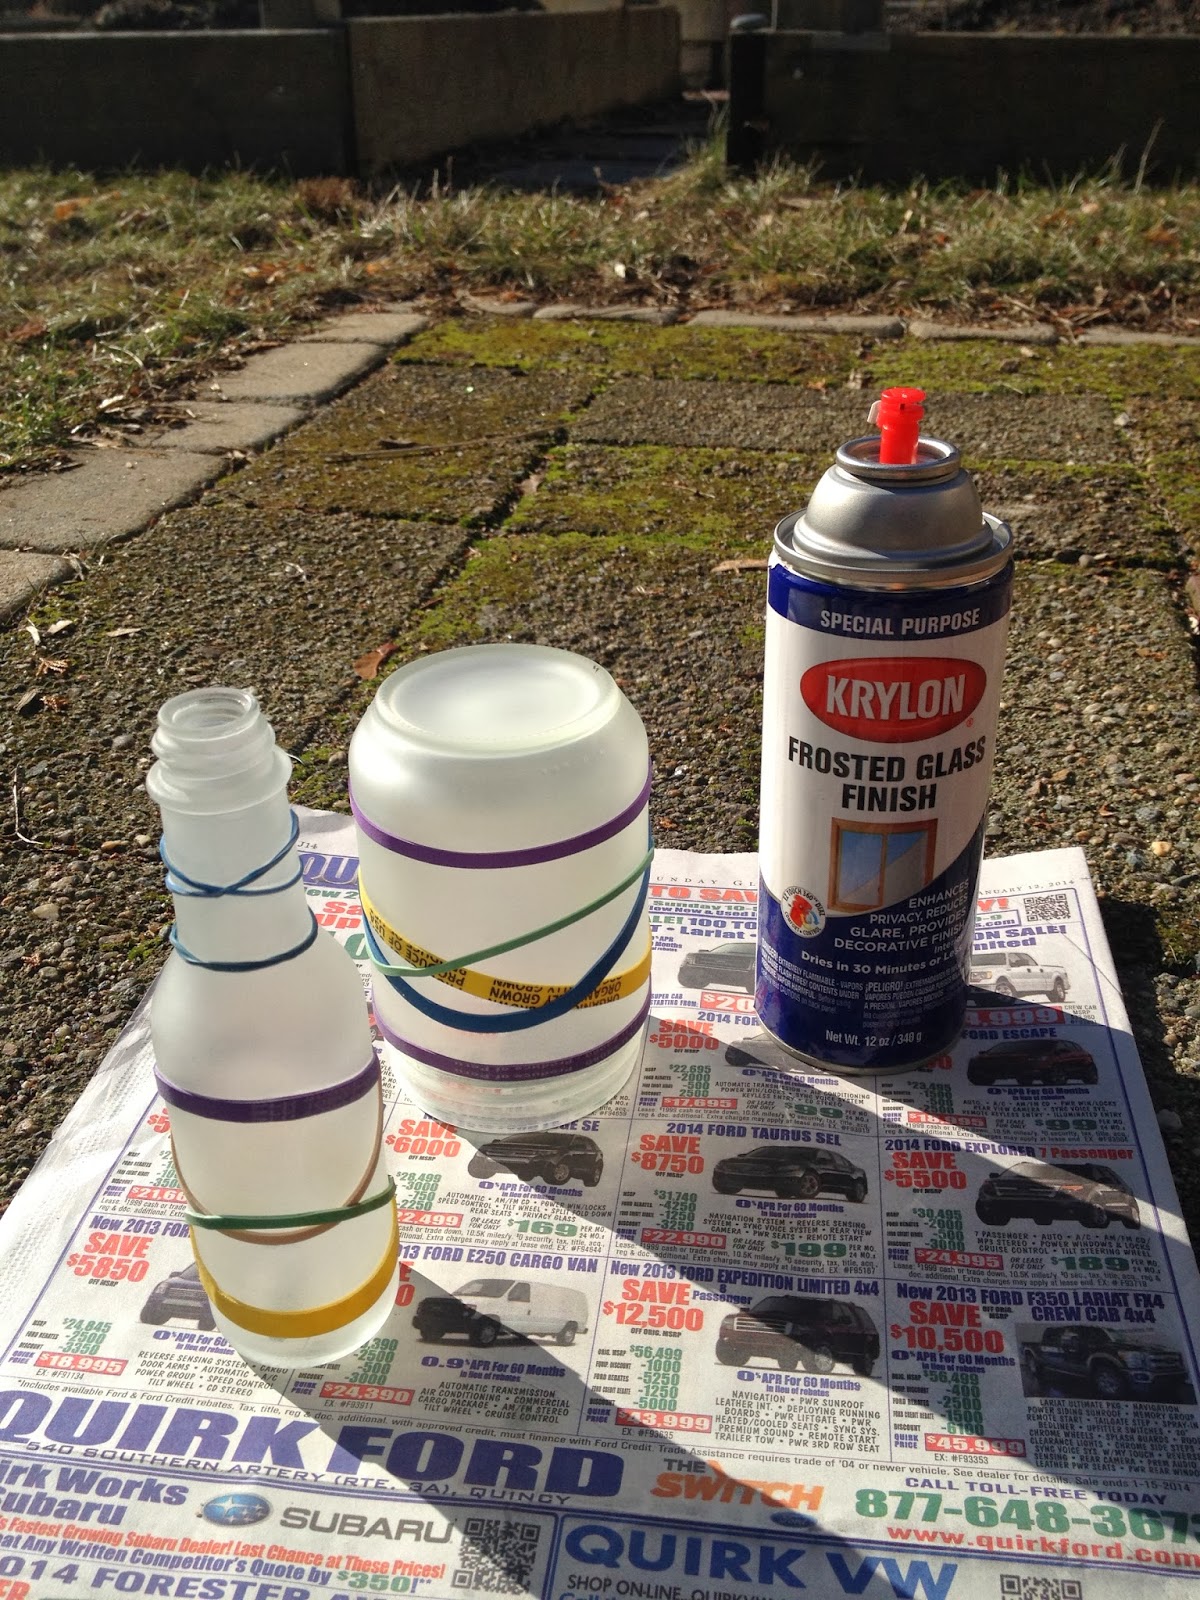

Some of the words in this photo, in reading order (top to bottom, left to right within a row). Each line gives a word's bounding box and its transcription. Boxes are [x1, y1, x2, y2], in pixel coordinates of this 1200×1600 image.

[821, 610, 894, 635] SPECIAL
[901, 608, 980, 635] PURPOSE
[826, 674, 966, 720] KRYLON
[789, 736, 904, 782] FROSTED
[916, 736, 986, 780] GLASS
[841, 783, 937, 812] FINISH
[909, 879, 969, 909] ENHANCES
[1049, 880, 1076, 888] 2014
[870, 909, 923, 924] PRIVACY,
[927, 893, 968, 918] REDUCES
[688, 917, 727, 928] 100
[1006, 925, 1067, 939] SALE!
[850, 926, 904, 939] GLARE,
[909, 907, 966, 935] PROVIDES
[834, 938, 928, 952] DECORATIVE
[931, 923, 965, 945] FINISH
[801, 950, 833, 969] Dries
[837, 960, 849, 971] in
[853, 964, 871, 974] 30
[875, 962, 926, 974] Minutes
[929, 957, 941, 966] or
[779, 956, 802, 975] EXTREMELY
[803, 969, 835, 986] FLAMMABLE
[840, 981, 863, 991] VAPORS
[490, 986, 541, 1004] GROWN
[808, 979, 838, 996] CONTENTS
[839, 990, 860, 1000] UNDER
[659, 1019, 714, 1036] SAVE
[698, 1011, 732, 1023] 2014
[649, 1033, 719, 1051] $5000
[825, 1029, 842, 1043] Net
[844, 1031, 860, 1046] Wt.
[865, 1036, 876, 1046] 12
[879, 1037, 889, 1047] oz
[916, 1032, 922, 1043] g
[1003, 1027, 1057, 1039] ESCAPE
[398, 1119, 458, 1140] SAVE
[585, 1121, 600, 1131] SE
[666, 1122, 703, 1136] 2014
[707, 1124, 746, 1138] FORD
[751, 1126, 812, 1143] TAURUS
[816, 1134, 842, 1147] SEL
[385, 1135, 461, 1158] $6000
[639, 1135, 701, 1154] SAVE
[885, 1140, 921, 1152] 2014
[924, 1140, 962, 1152] FORD
[965, 1143, 1036, 1157] EXPLORER
[1040, 1146, 1048, 1157] 7
[1051, 1148, 1133, 1162] Passenger
[630, 1152, 705, 1175] $8750
[892, 1152, 957, 1170] SAVE
[396, 1171, 442, 1183] $28,499
[884, 1169, 967, 1190] $5500
[89, 1215, 122, 1231] New
[124, 1219, 160, 1235] 2013
[507, 1218, 578, 1237] $169
[84, 1231, 154, 1258] SAVE
[644, 1229, 724, 1248] $22,990
[771, 1241, 847, 1258] $199
[66, 1253, 150, 1283] $5850
[423, 1245, 464, 1263] FORD
[466, 1249, 506, 1266] E250
[509, 1253, 564, 1270] CARGO
[567, 1257, 599, 1273] VAN
[917, 1249, 1001, 1268] $24,995
[1051, 1256, 1130, 1271] $189
[610, 1260, 640, 1277] New
[642, 1262, 677, 1279] 2013
[680, 1265, 714, 1282] FORD
[718, 1270, 794, 1288] EXPEDITION
[797, 1277, 851, 1295] LIMITED
[854, 1280, 880, 1296] 4x4
[621, 1278, 691, 1306] SAVE
[692, 1290, 753, 1305] Passenger
[897, 1283, 932, 1300] New
[936, 1285, 977, 1302] 2013
[980, 1288, 1023, 1305] FORD
[1028, 1291, 1070, 1308] F350
[1073, 1292, 1130, 1309] LARIAT
[1133, 1293, 1165, 1309] FX4
[603, 1304, 704, 1331] $12,500
[908, 1301, 982, 1327] SAVE
[1031, 1307, 1081, 1322] CREW
[1085, 1307, 1121, 1322] CAB
[1124, 1308, 1156, 1323] 4x4
[890, 1324, 1005, 1354] $10,500
[40, 1352, 122, 1374] $18,995
[630, 1345, 682, 1360] $56,499
[761, 1374, 782, 1385] APR
[785, 1375, 801, 1386] For
[803, 1376, 817, 1387] 60
[820, 1378, 861, 1390] Months
[923, 1369, 979, 1385] $56,499
[61, 1387, 104, 1399] available
[106, 1389, 128, 1398] Ford
[130, 1391, 137, 1399] &
[140, 1392, 162, 1401] Ford
[165, 1395, 193, 1405] Credit
[324, 1383, 411, 1403] $24,390
[618, 1409, 710, 1431] $43,999
[0, 1389, 320, 1470] QUIRK
[326, 1425, 624, 1498] FORD
[927, 1435, 1025, 1457] $45,999
[26, 1440, 74, 1456] 540
[83, 1447, 219, 1472] SOUTHERN
[227, 1463, 325, 1483] ARTERY
[334, 1474, 396, 1490] (RTE.
[410, 1481, 457, 1497] 3A),
[470, 1487, 571, 1505] QUINCY
[664, 1458, 706, 1473] THE
[0, 1459, 52, 1488] irk
[56, 1466, 189, 1505] Works
[650, 1460, 824, 1511] SWITCH
[906, 1477, 960, 1491] CALL
[965, 1481, 1088, 1500] TOLL-FREE
[1097, 1490, 1167, 1505] TODAY
[280, 1506, 453, 1544] SUBARU
[9, 1518, 61, 1538] Fastest
[62, 1524, 124, 1546] Growing
[125, 1532, 178, 1551] Subaru
[180, 1537, 235, 1557] Dealer!
[236, 1541, 268, 1560] Last
[270, 1546, 323, 1567] Chance
[325, 1555, 342, 1569] at
[344, 1554, 390, 1575] These
[391, 1560, 446, 1579] Prices!
[887, 1527, 1200, 1569] www.quirkford.com
[21, 1536, 59, 1555] Any
[60, 1538, 127, 1562] Written
[129, 1547, 247, 1574] Competitor's
[250, 1560, 304, 1581] Quote
[307, 1567, 332, 1586] by
[565, 1525, 806, 1589] QUIRK
[825, 1552, 958, 1600] VW
[0, 1555, 80, 1584] 014
[92, 1567, 311, 1600] FORESTER
[568, 1574, 612, 1593] SHOP
